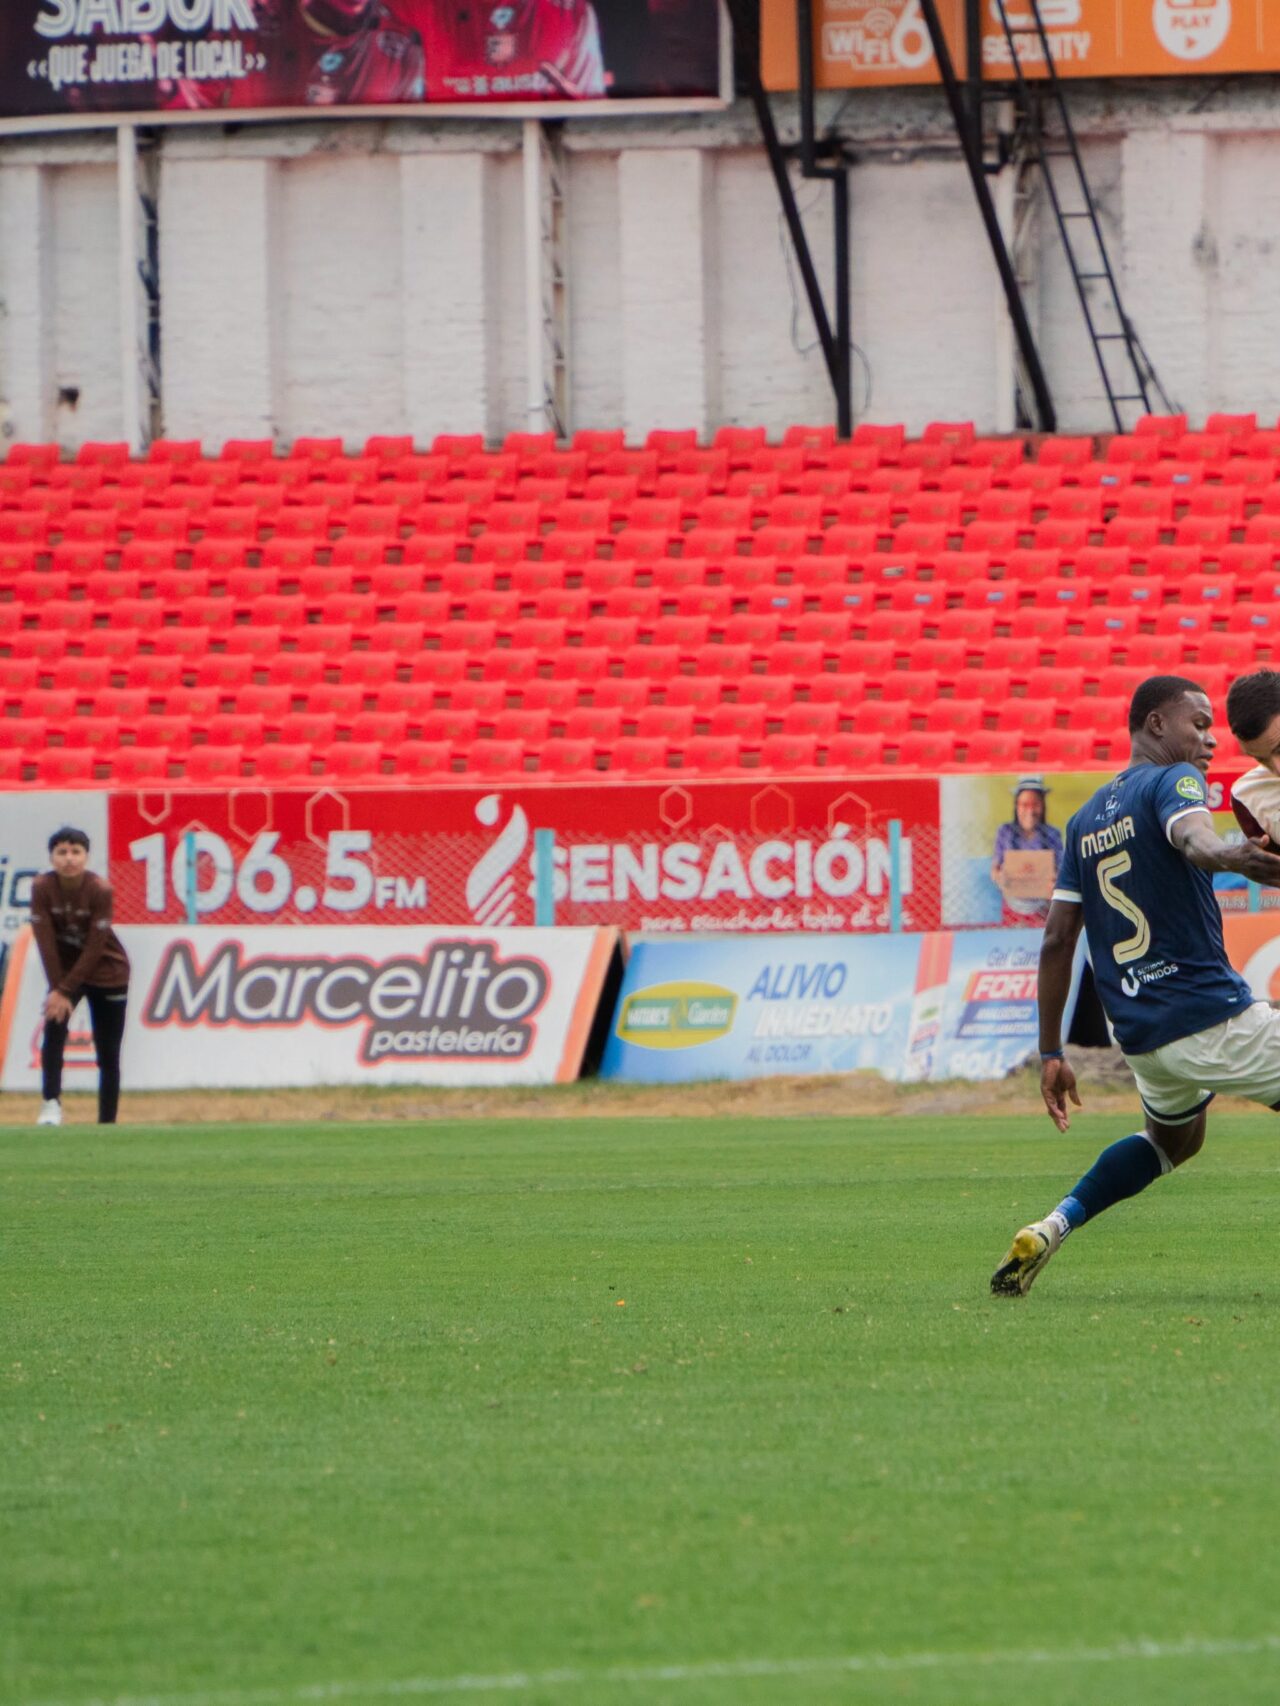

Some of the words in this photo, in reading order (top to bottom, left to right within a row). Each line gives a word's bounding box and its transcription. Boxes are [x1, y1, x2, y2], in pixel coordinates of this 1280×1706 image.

[1170, 14, 1212, 30] PLAY
[91, 42, 154, 82] JUEGA
[157, 41, 183, 79] DE
[1081, 816, 1136, 859] MEDINA
[130, 831, 373, 912] 106.5
[375, 877, 427, 909] FM
[529, 822, 912, 903] SENSACIÓN
[875, 903, 914, 928] da
[1096, 850, 1151, 965] 5
[152, 942, 545, 1021] Marcelito
[746, 962, 848, 1001] ALIVIO
[973, 973, 1040, 1000] FORT
[1139, 963, 1179, 984] UNIDOS
[369, 1022, 525, 1057] pastelería
[754, 1002, 893, 1039] INMEDIATO
